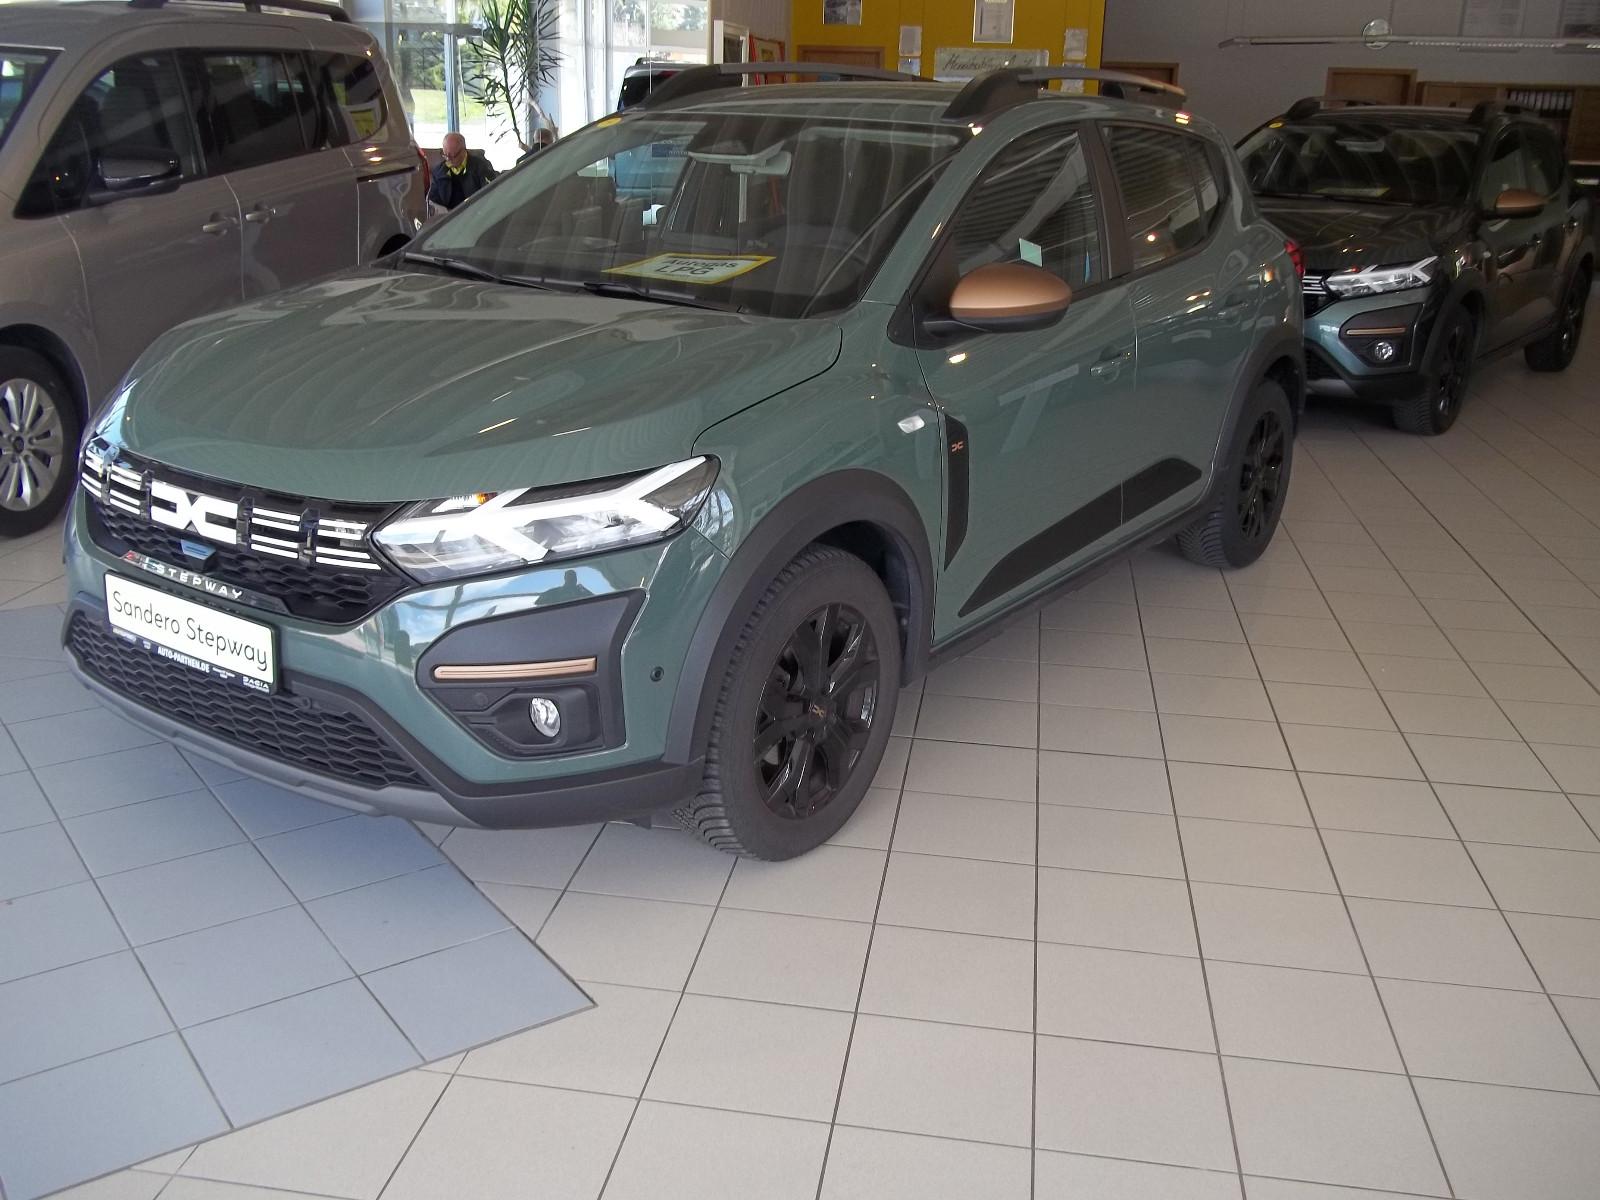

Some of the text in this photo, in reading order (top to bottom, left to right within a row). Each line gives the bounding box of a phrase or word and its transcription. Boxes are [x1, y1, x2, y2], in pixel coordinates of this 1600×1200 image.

[655, 264, 714, 276] LPG
[156, 563, 243, 600] STEPWAY
[112, 590, 268, 672] Sandero Stepway
